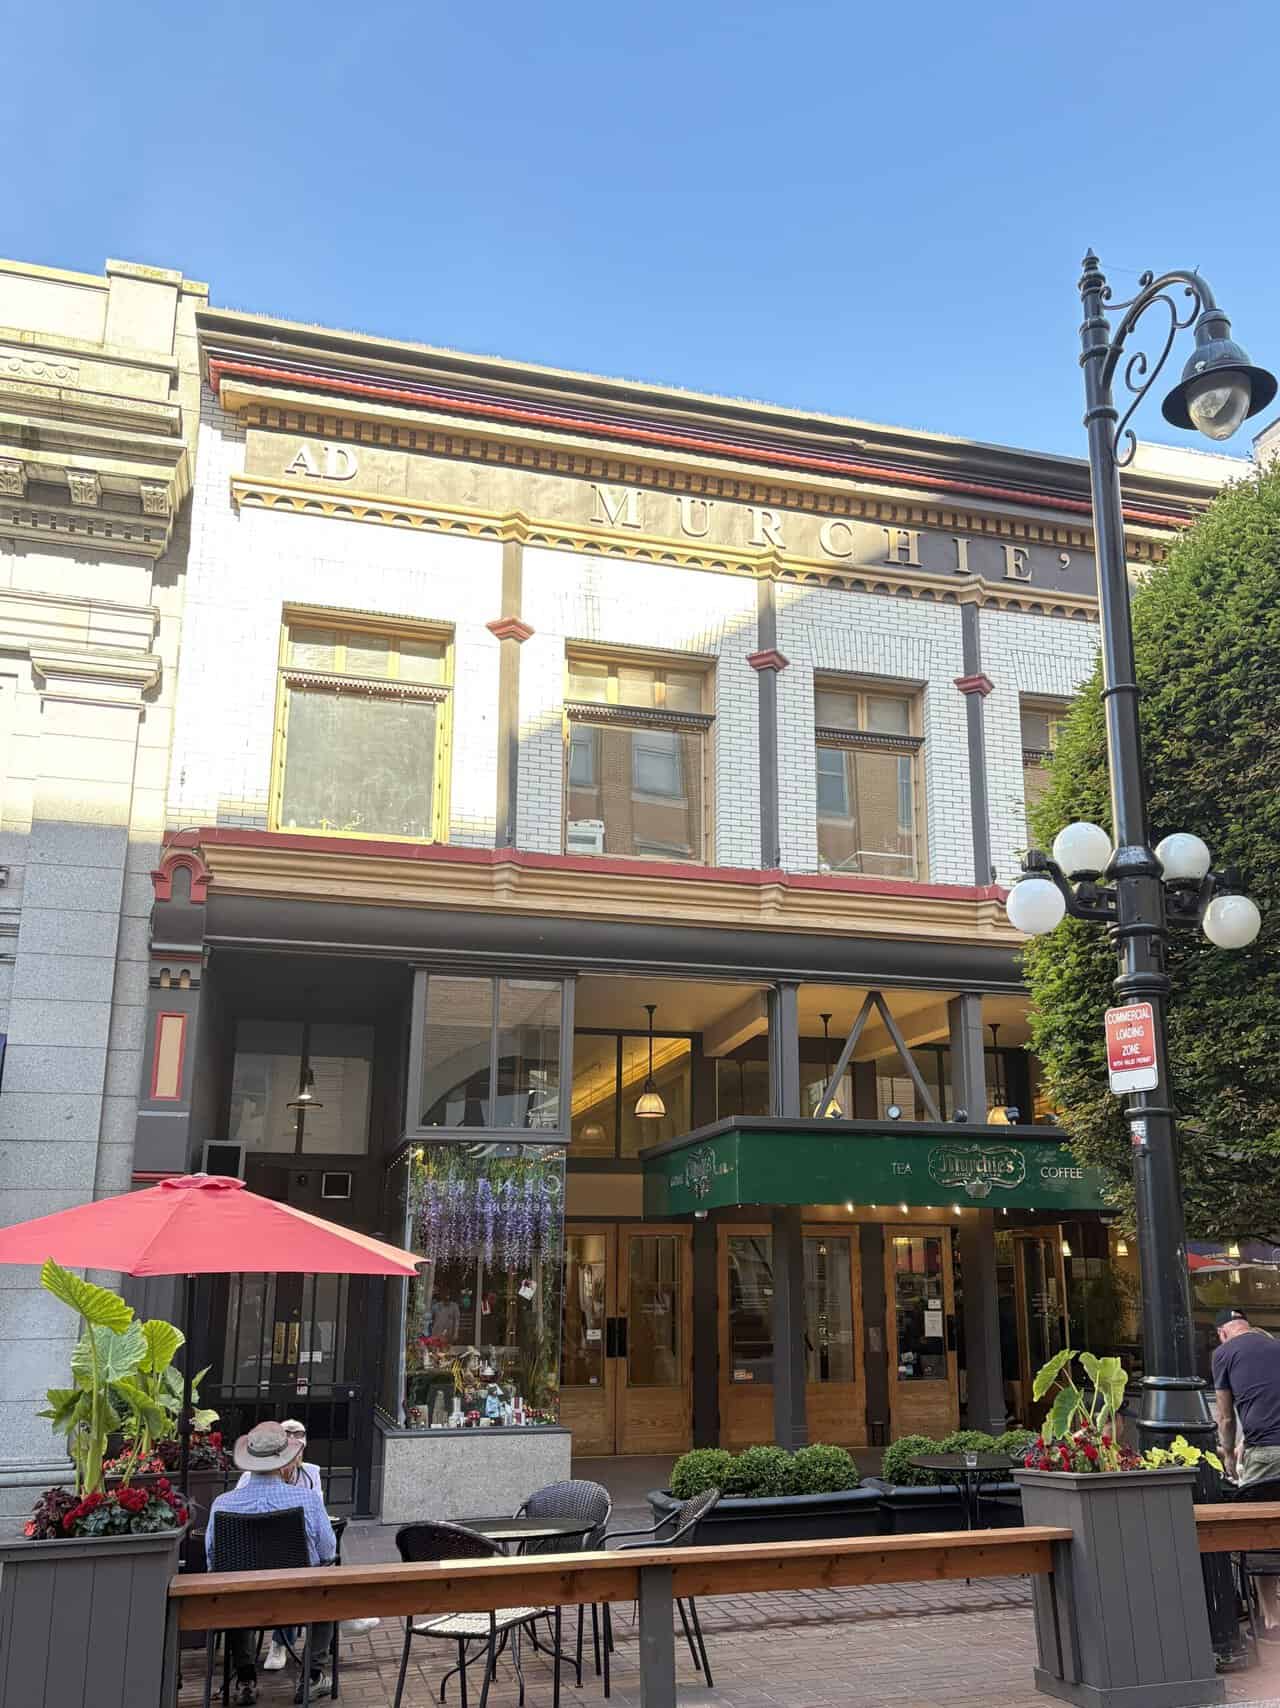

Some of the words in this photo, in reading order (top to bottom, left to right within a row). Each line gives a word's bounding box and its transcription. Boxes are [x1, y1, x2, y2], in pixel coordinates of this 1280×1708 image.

[284, 444, 358, 481] AD
[590, 484, 1072, 583] MURCHIE'
[1107, 1008, 1151, 1025] COMMERCIAL
[1116, 1026, 1145, 1041] LOADING
[1121, 1043, 1141, 1057] ZONE
[891, 1162, 913, 1175] TEA
[1040, 1166, 1084, 1179] COFFEE
